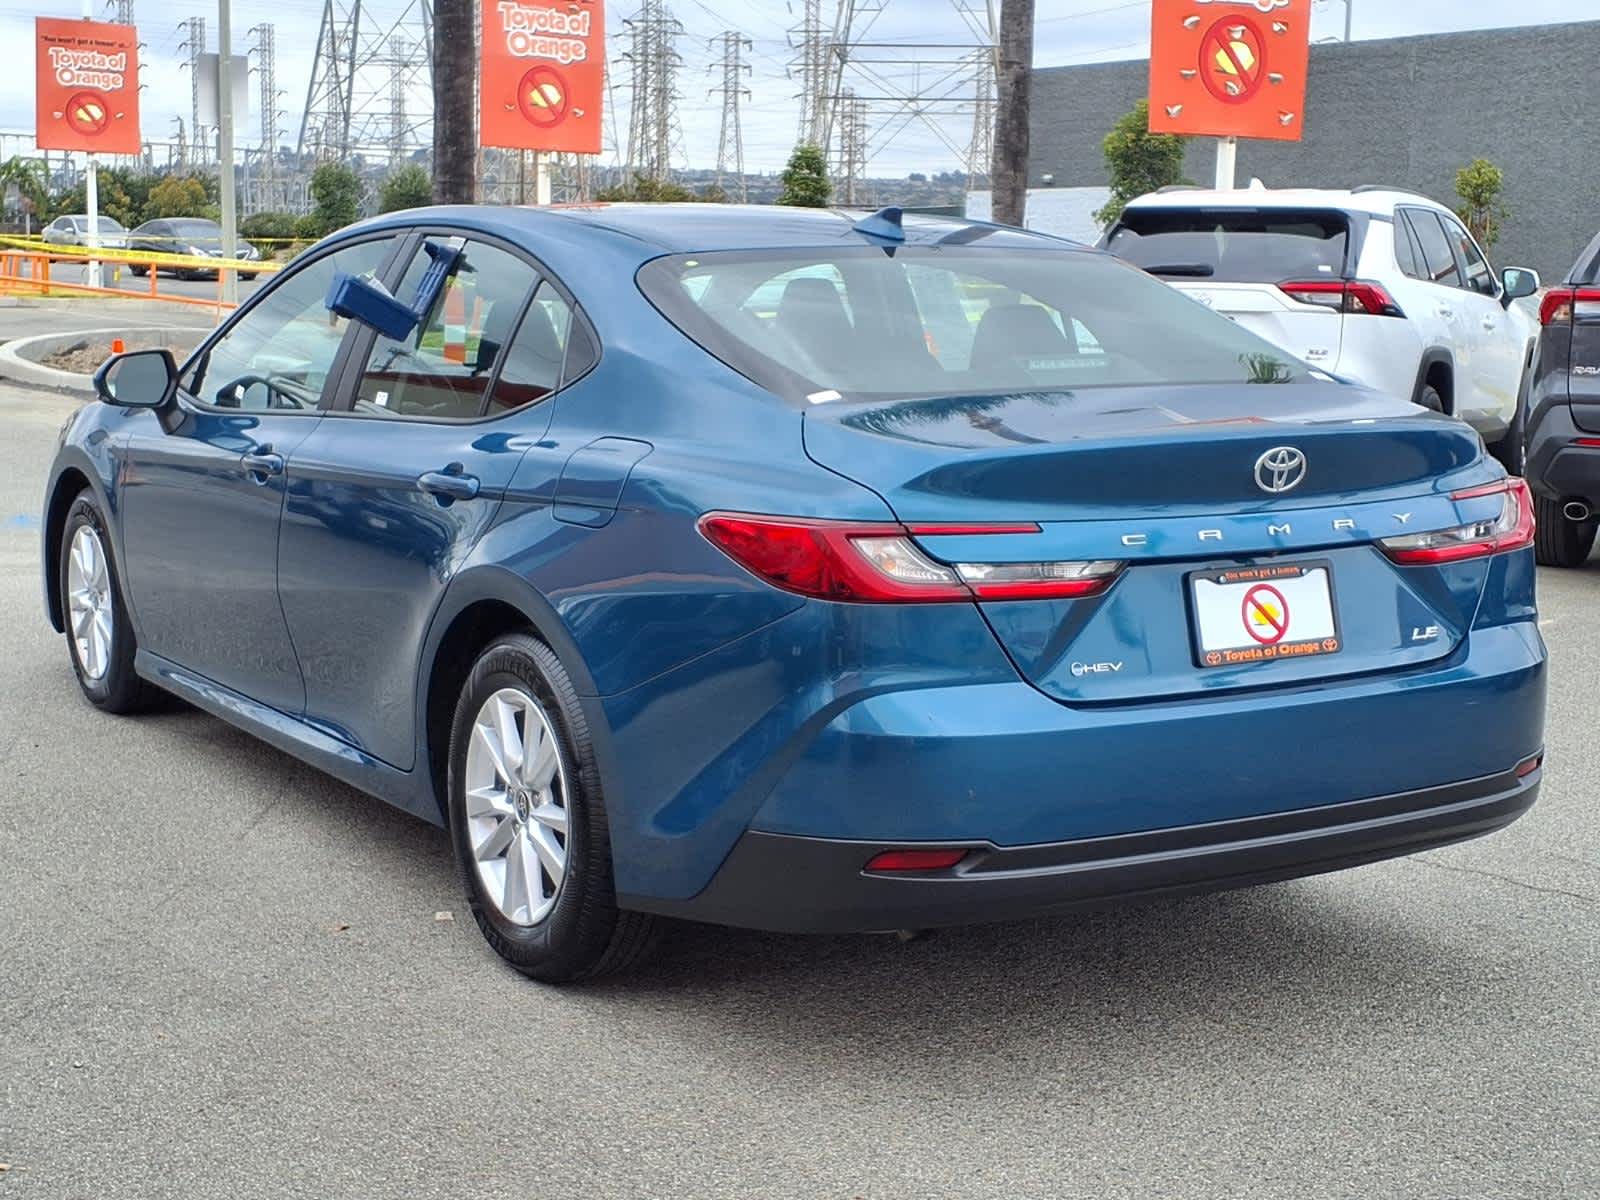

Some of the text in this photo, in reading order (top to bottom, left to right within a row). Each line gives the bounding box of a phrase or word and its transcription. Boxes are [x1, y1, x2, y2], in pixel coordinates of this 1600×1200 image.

[498, 1, 590, 36] Toyota of
[507, 29, 586, 64] Orange
[48, 47, 126, 71] Toyota of
[56, 67, 124, 91] Orange
[1120, 512, 1411, 546] CAMRY
[1412, 625, 1439, 641] LE
[1224, 642, 1320, 661] Toyota of Orange
